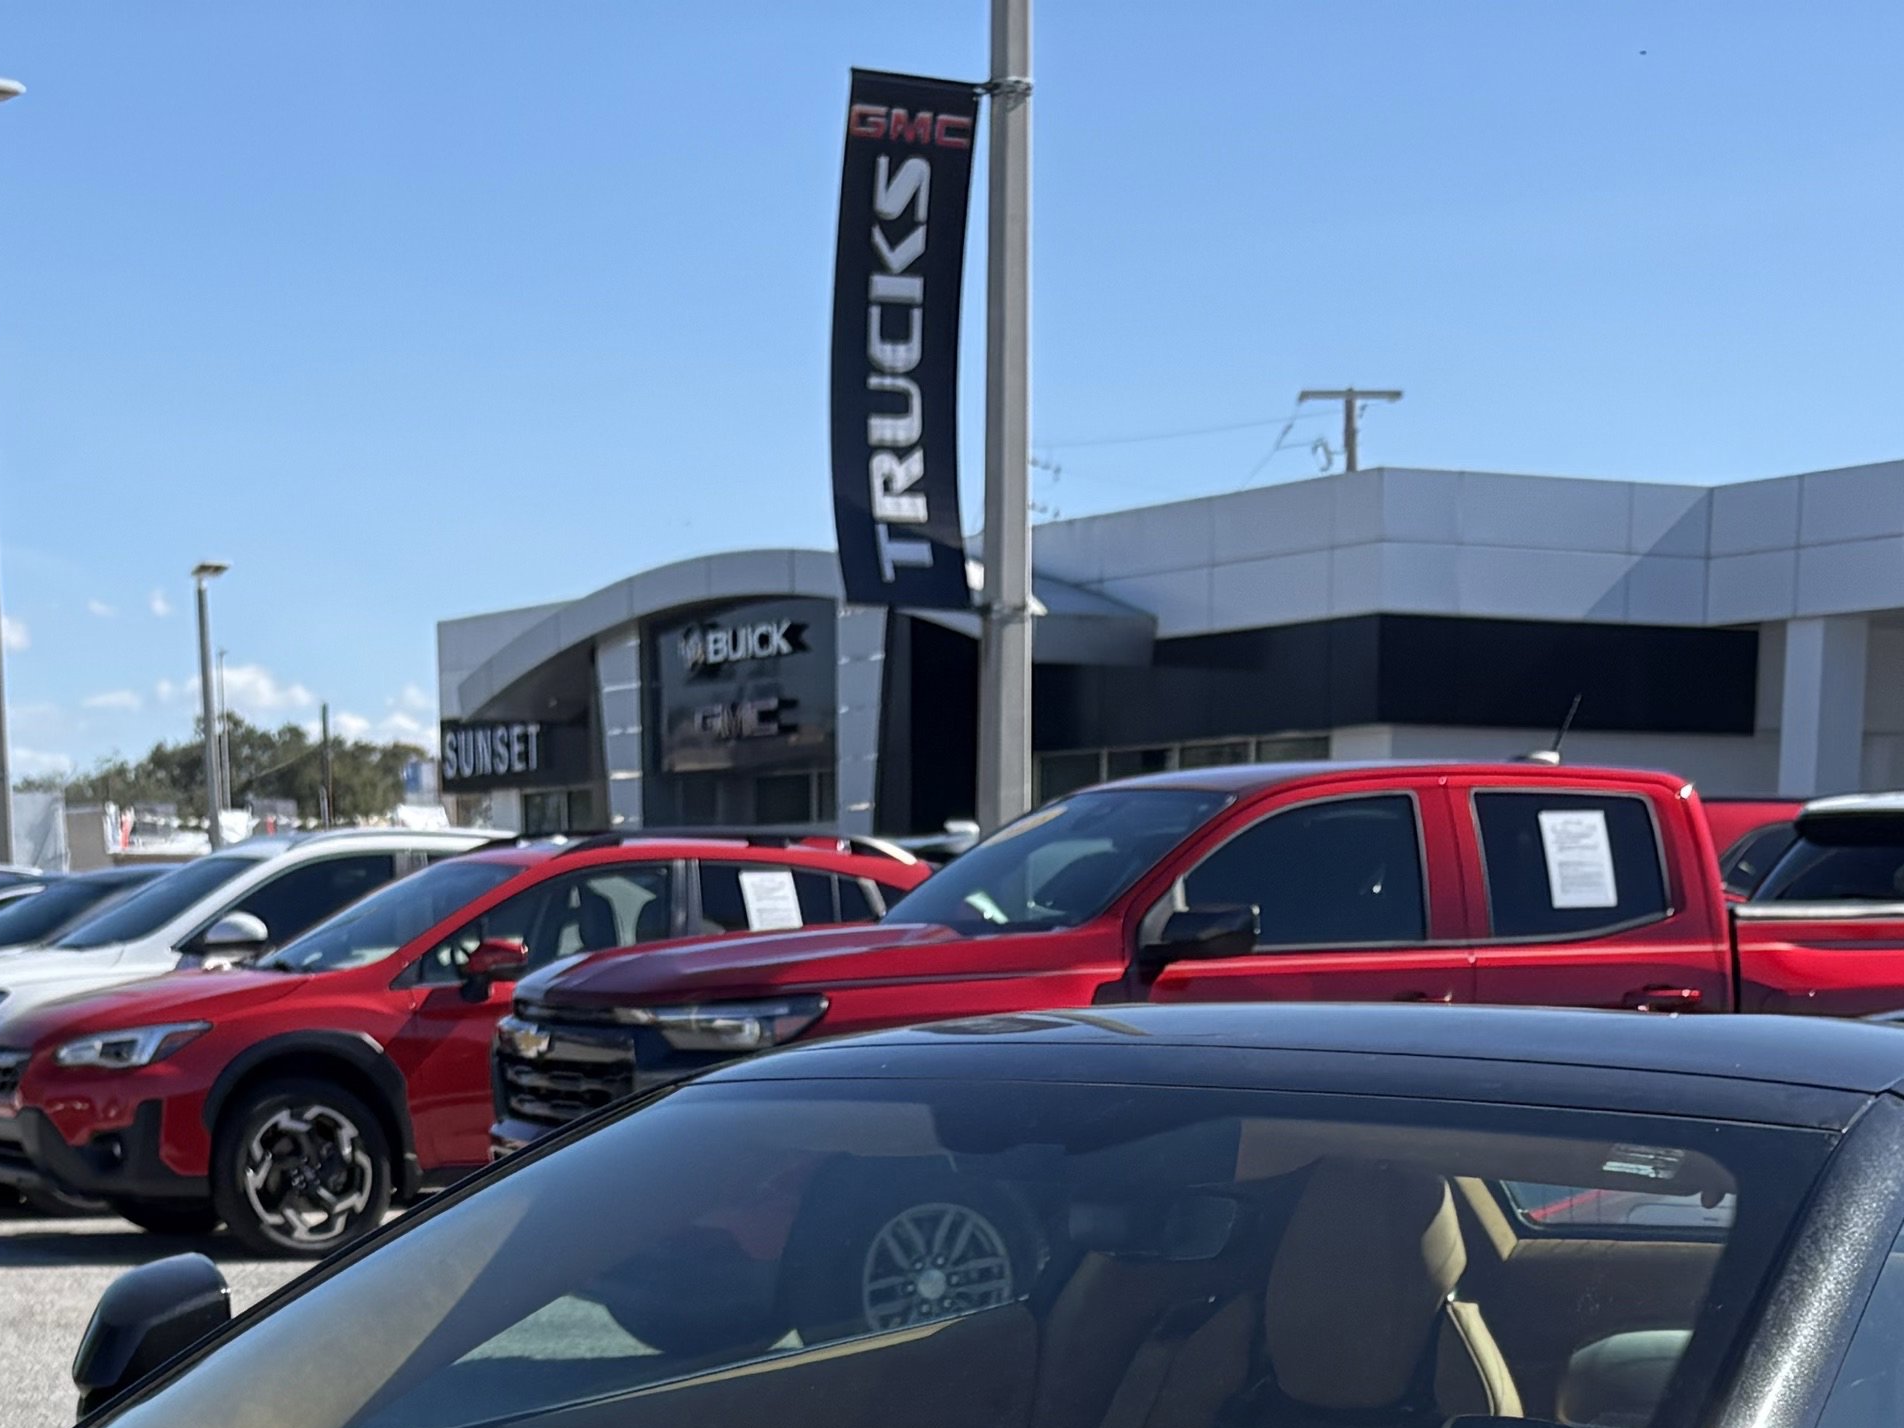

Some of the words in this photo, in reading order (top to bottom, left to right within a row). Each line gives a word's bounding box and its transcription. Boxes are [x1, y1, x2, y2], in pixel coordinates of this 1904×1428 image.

[849, 104, 973, 149] GMC
[866, 153, 934, 583] TRUCKS
[706, 618, 794, 665] BUICK
[699, 698, 780, 738] GMC
[442, 722, 541, 781] SUNSET
